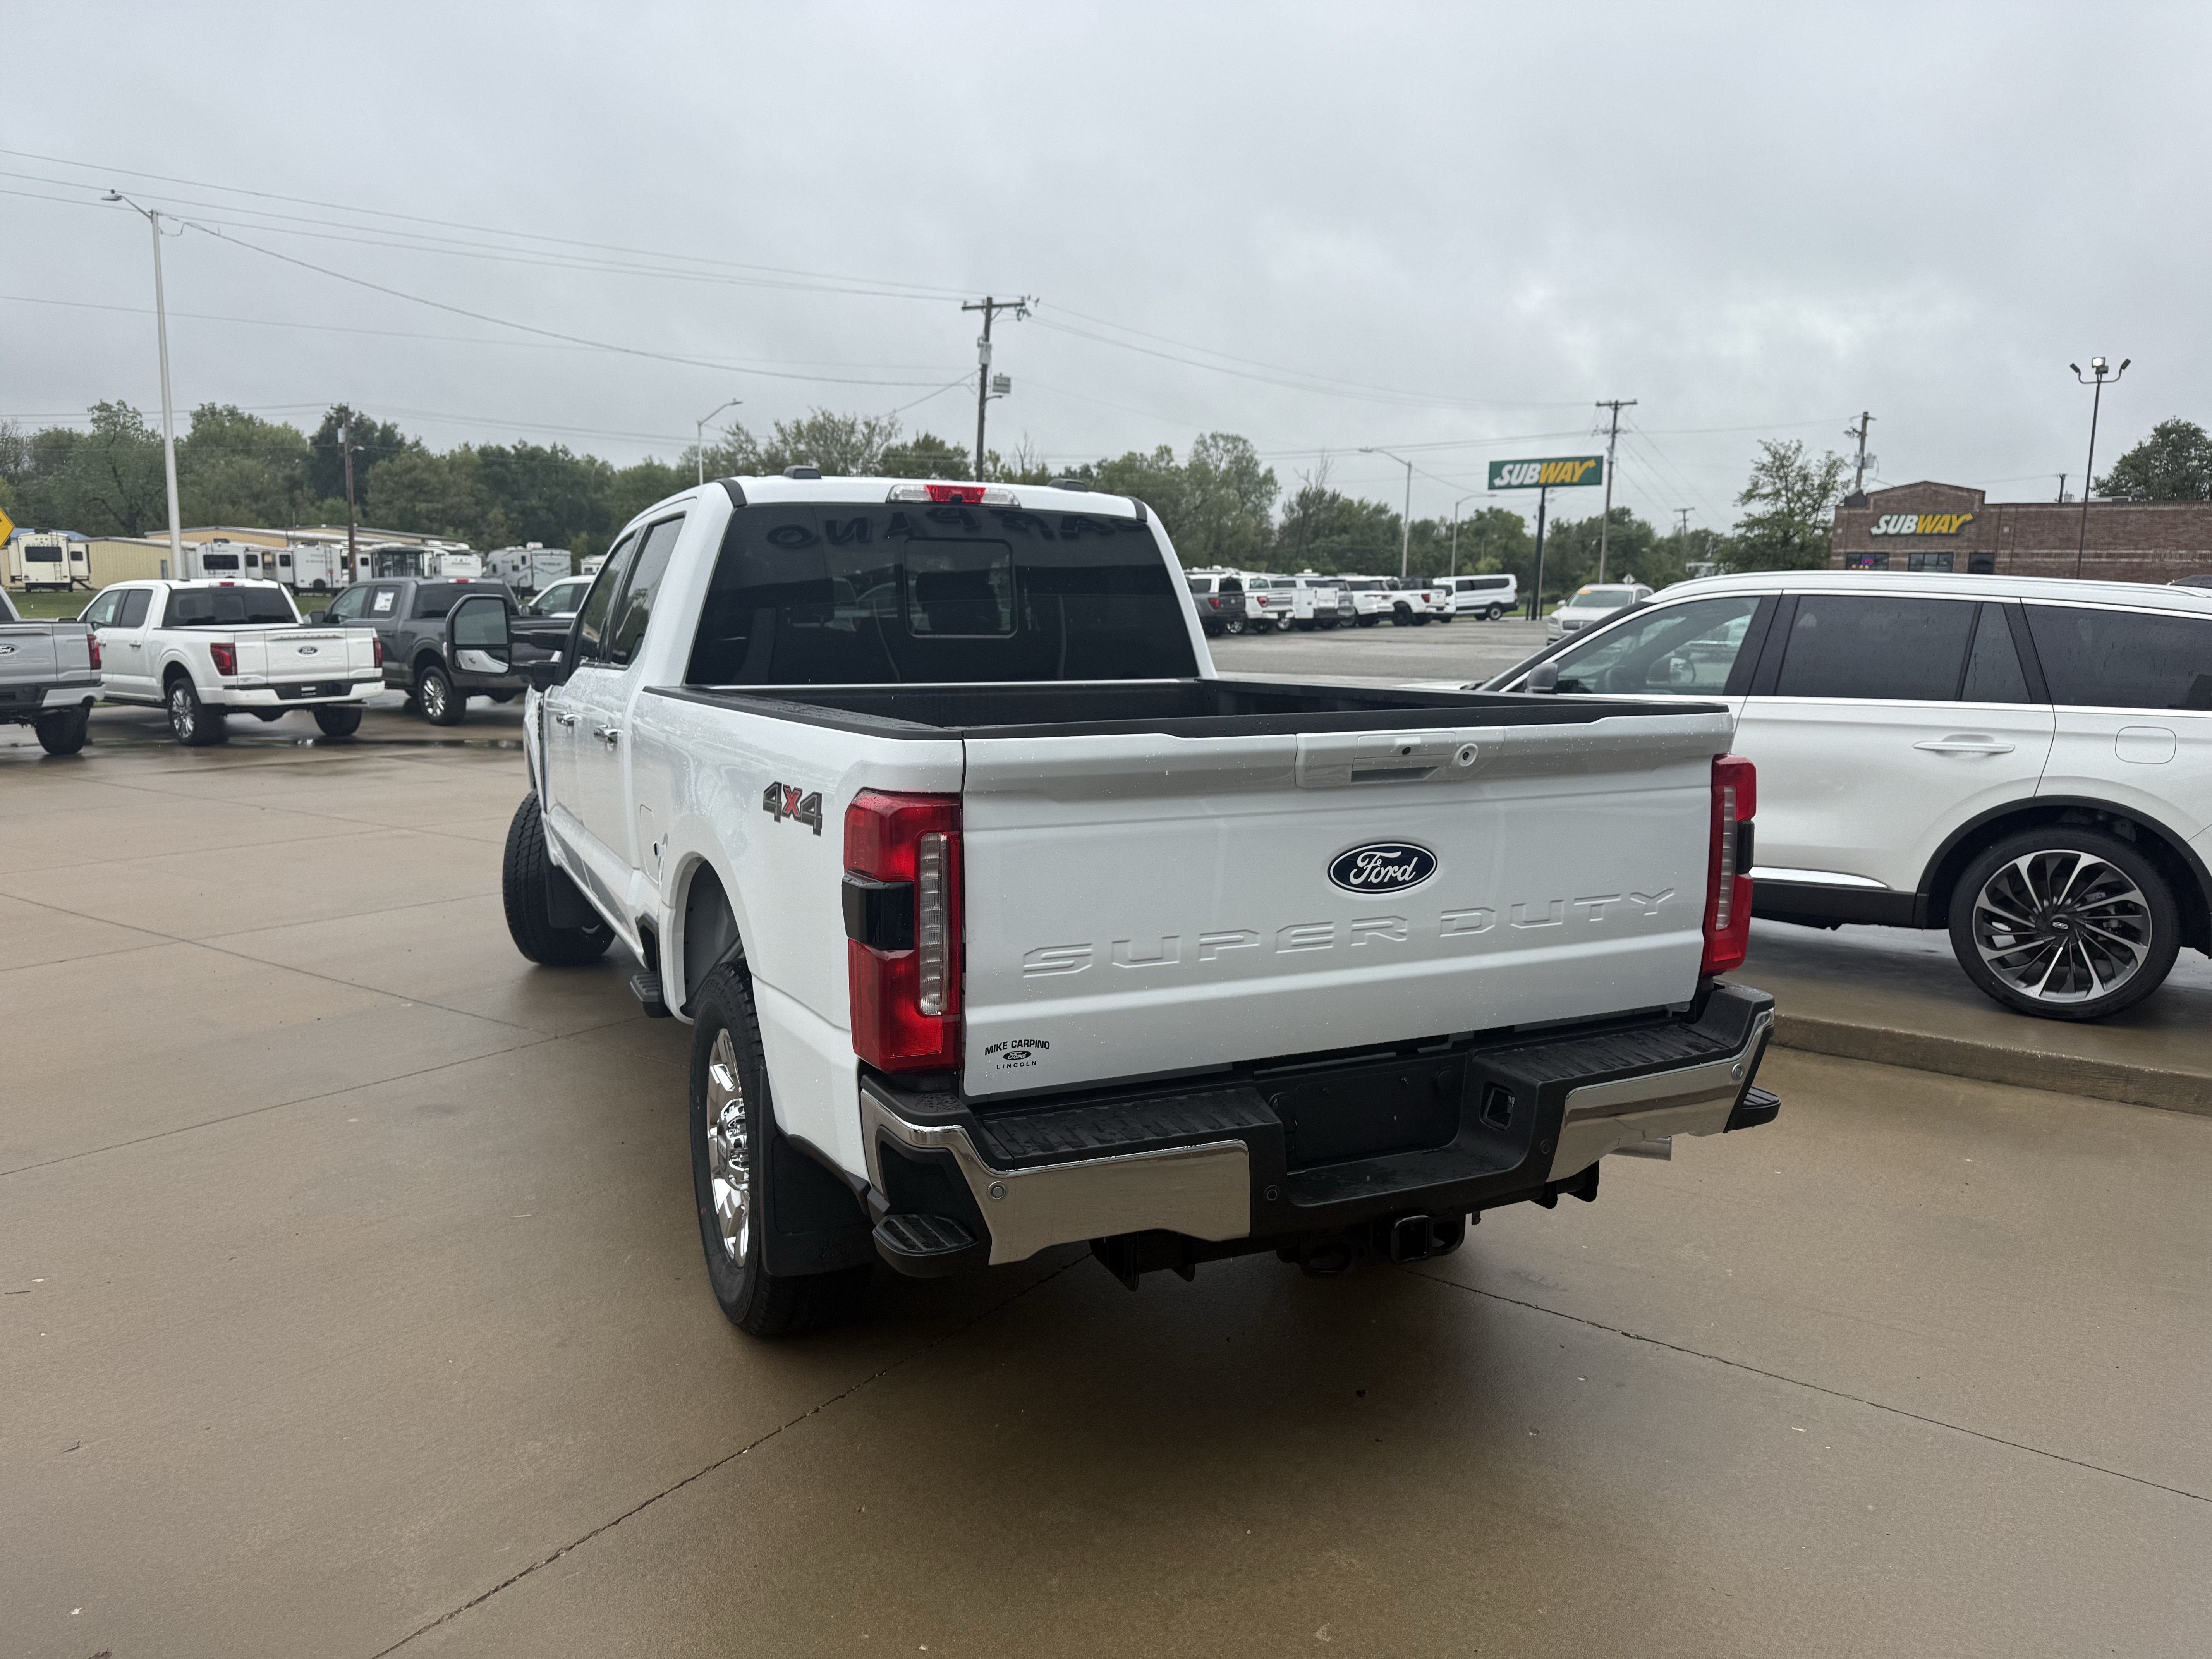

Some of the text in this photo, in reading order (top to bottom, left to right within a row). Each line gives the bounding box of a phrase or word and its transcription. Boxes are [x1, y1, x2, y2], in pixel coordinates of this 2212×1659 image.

[1493, 459, 1596, 487] SUBWAY
[1869, 512, 1974, 535] SUBWAY
[1349, 851, 1418, 884] Ford
[1023, 888, 1674, 978] SUPER DUTY
[985, 1039, 1050, 1056] MIKE CARPINO
[1007, 1051, 1027, 1060] Ford
[996, 1061, 1036, 1069] LINCOLN
